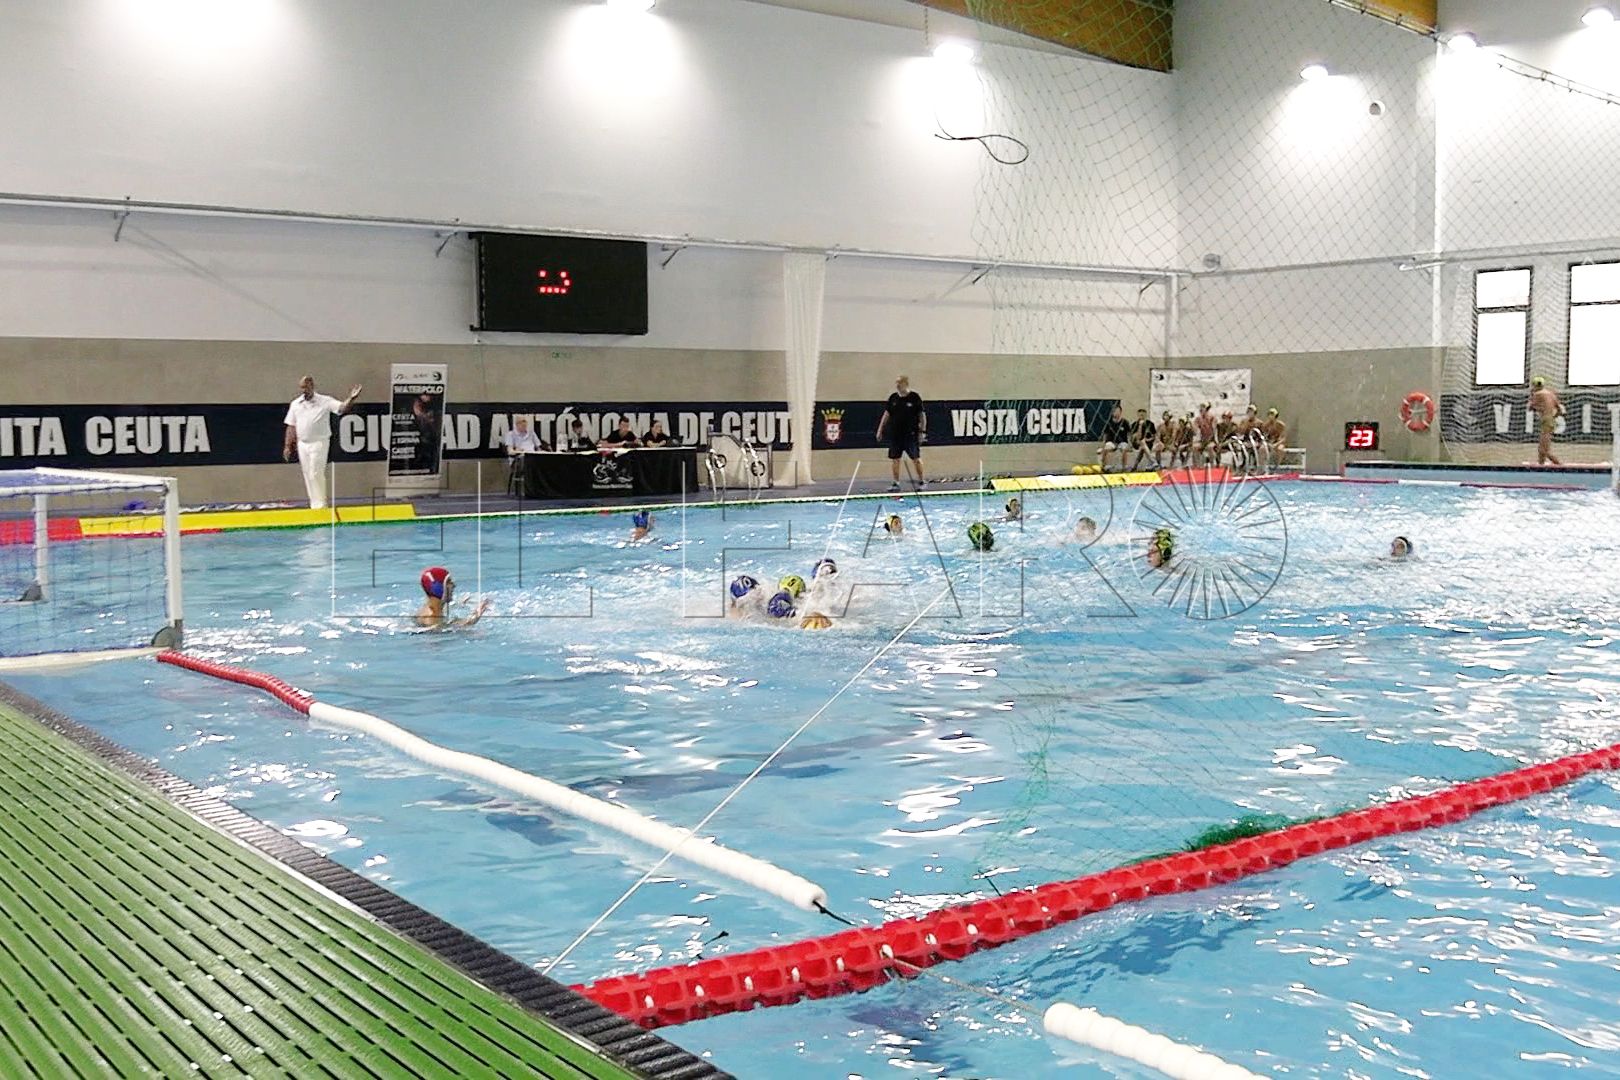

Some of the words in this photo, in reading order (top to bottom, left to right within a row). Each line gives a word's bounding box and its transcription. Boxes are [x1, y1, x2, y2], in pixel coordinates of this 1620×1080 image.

[85, 415, 212, 455] CEUTA
[339, 414, 481, 453] CIAD
[951, 409, 1019, 437] VISITA
[1026, 408, 1087, 435] CEUTA
[1349, 430, 1374, 447] 23
